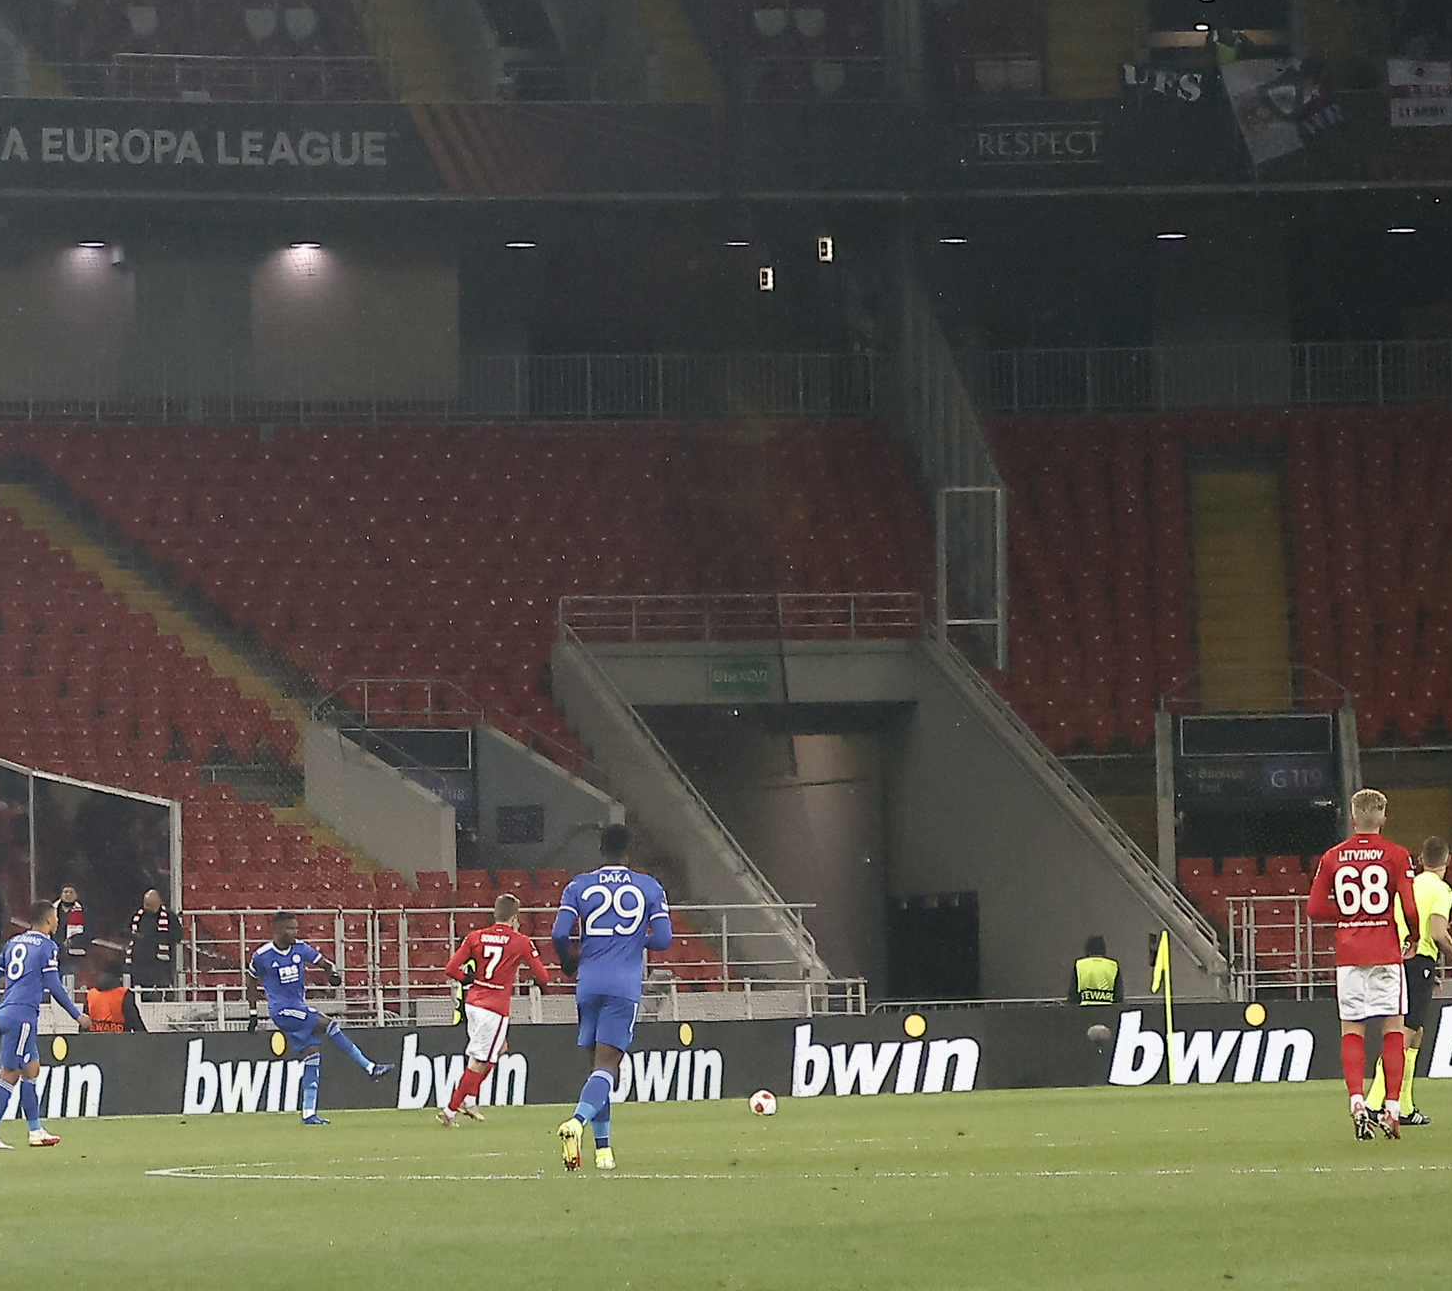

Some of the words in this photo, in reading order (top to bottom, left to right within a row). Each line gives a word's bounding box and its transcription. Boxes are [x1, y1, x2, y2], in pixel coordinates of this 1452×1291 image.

[41, 127, 204, 165] EUROPA
[216, 130, 387, 167] LEAGUE
[978, 130, 1101, 157] RESPECT
[1338, 849, 1384, 862] LITVINOV
[599, 873, 632, 884] DAKA
[1334, 864, 1390, 916] 68
[581, 884, 646, 936] 29
[480, 933, 511, 945] SOBOLEV
[7, 943, 28, 981] 8
[278, 964, 299, 977] FBS
[483, 944, 504, 980] 7
[791, 1014, 980, 1098] bwin
[1108, 1004, 1314, 1086] bwin
